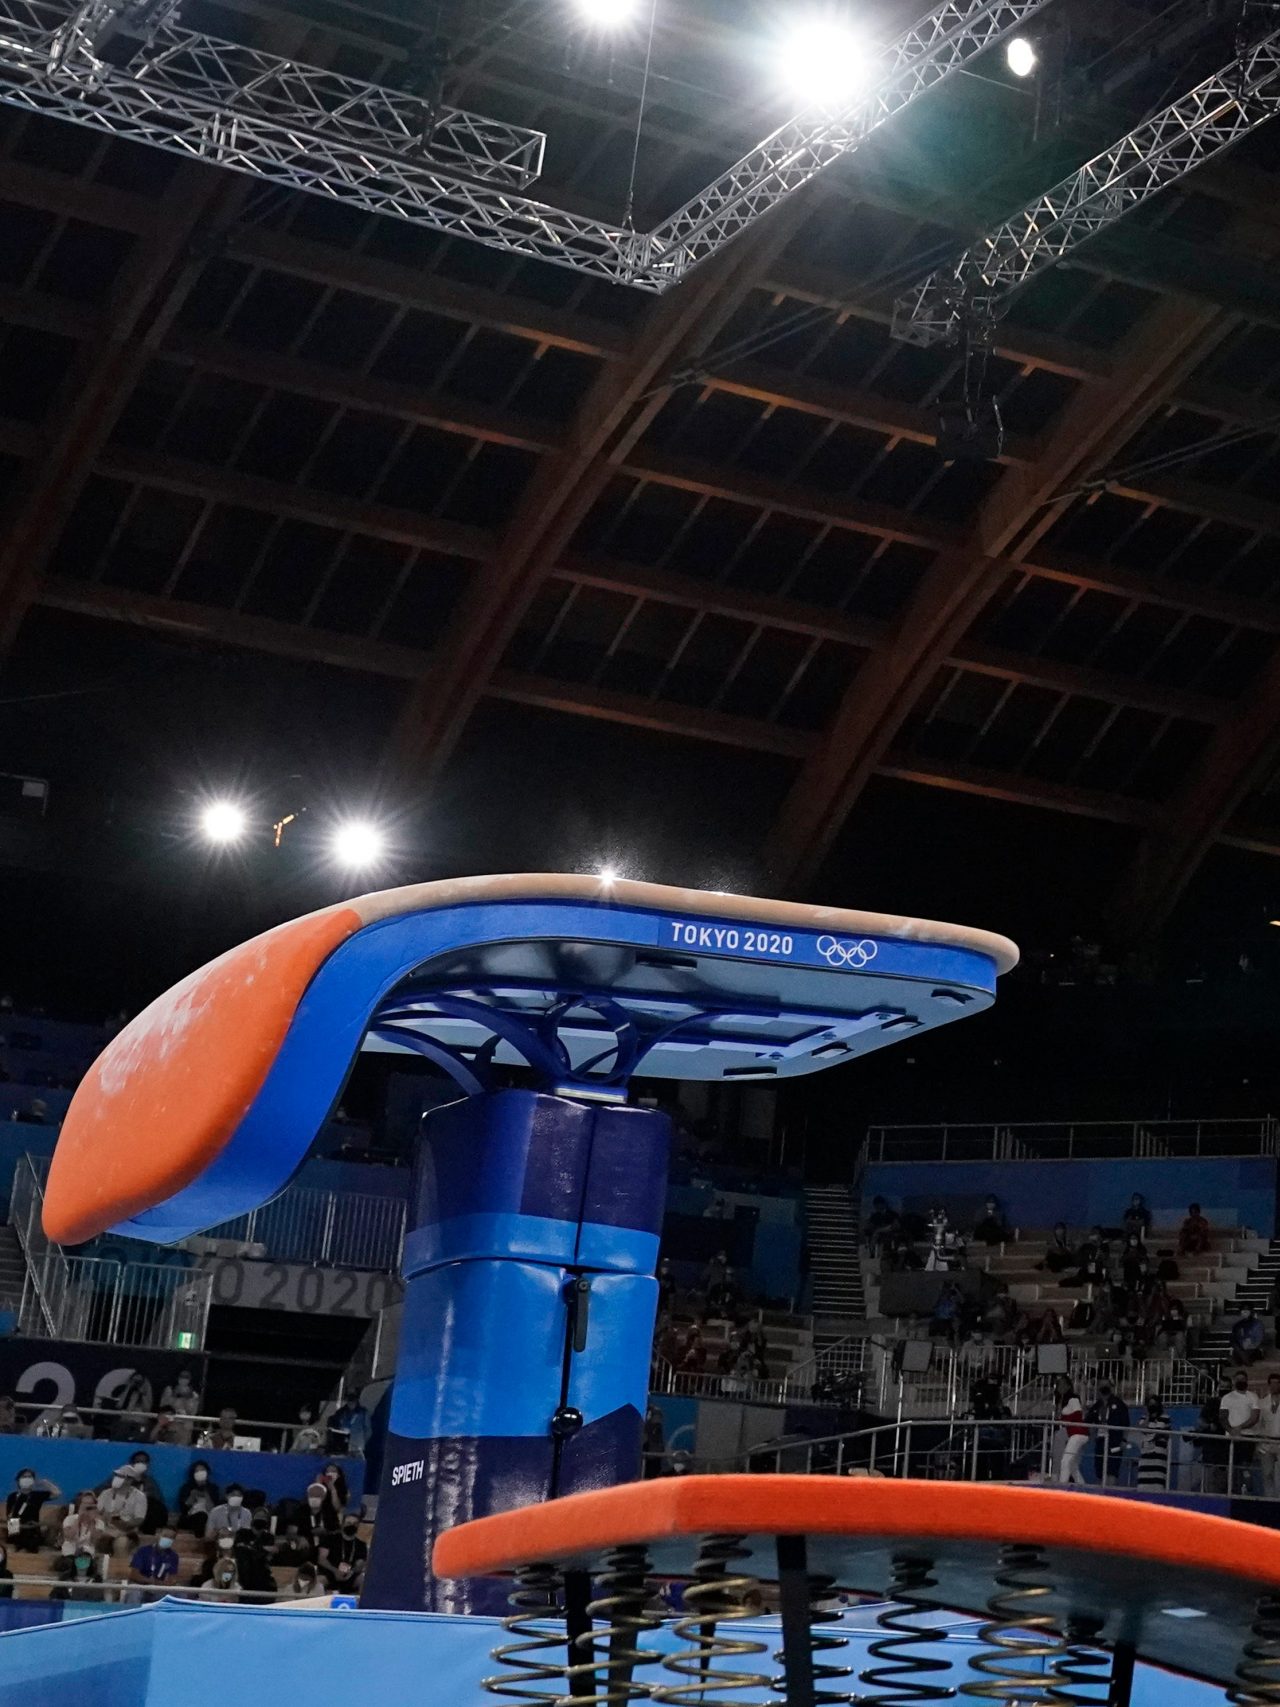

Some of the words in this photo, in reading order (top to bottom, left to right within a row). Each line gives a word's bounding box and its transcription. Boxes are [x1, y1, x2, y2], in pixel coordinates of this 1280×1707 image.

[671, 922, 739, 949] TOKYO
[743, 931, 793, 955] 2020
[392, 1460, 424, 1486] SPIETH
